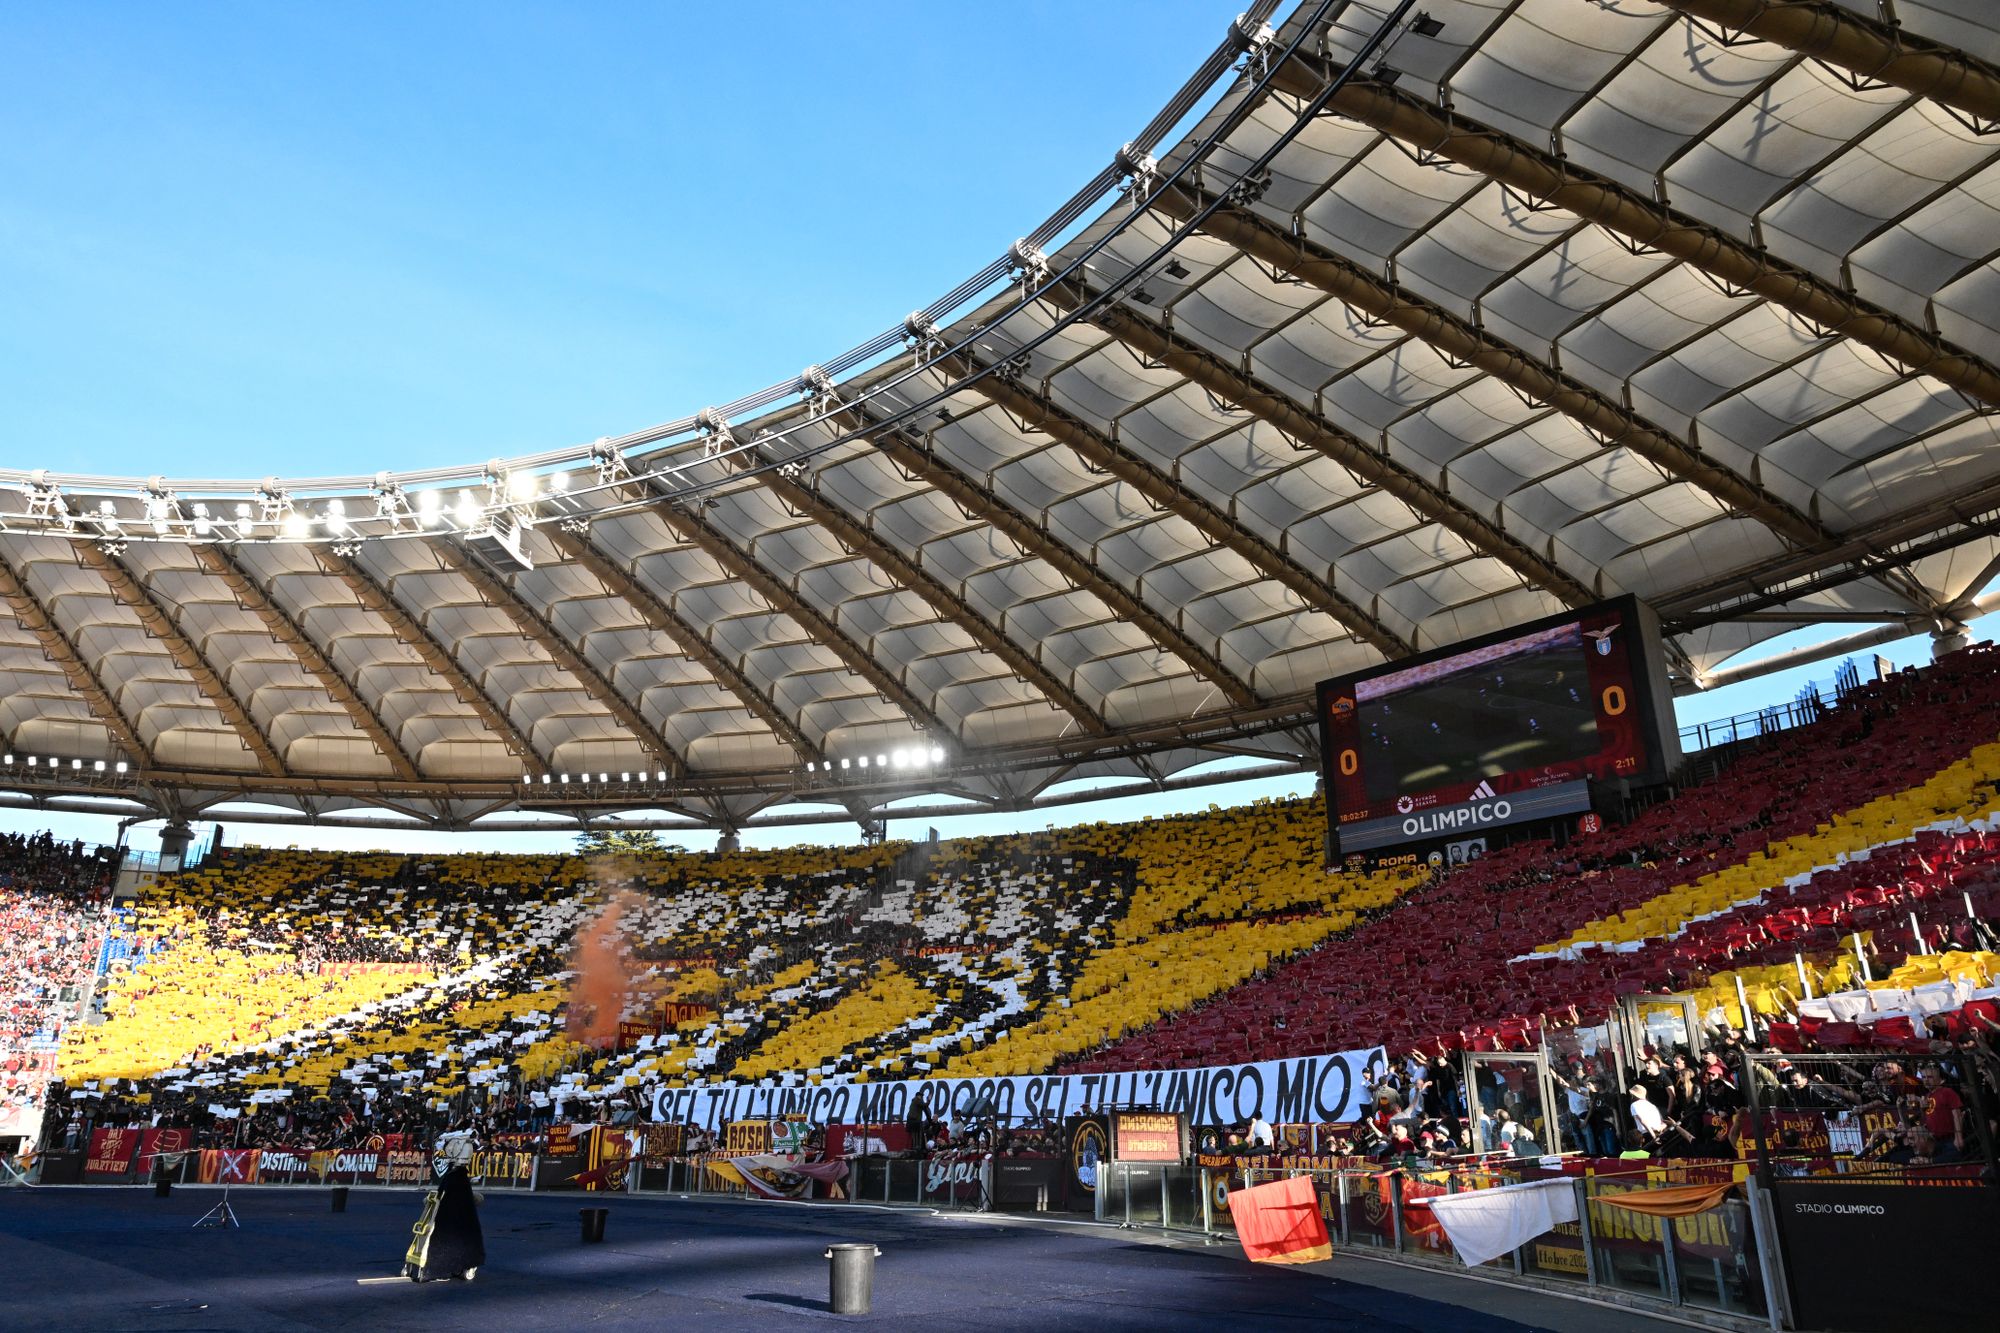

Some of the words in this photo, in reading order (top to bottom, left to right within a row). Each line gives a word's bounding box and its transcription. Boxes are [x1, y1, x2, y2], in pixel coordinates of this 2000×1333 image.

[1602, 685, 1627, 716] 0
[1340, 749, 1358, 776] 0
[1615, 757, 1635, 769] 2:11
[1403, 800, 1511, 835] OLIMPICO
[1379, 853, 1417, 868] ROMA
[1275, 1054, 1351, 1124] MIO
[1795, 1203, 1832, 1214] STADIO
[1834, 1204, 1885, 1215] OLIMPICO
